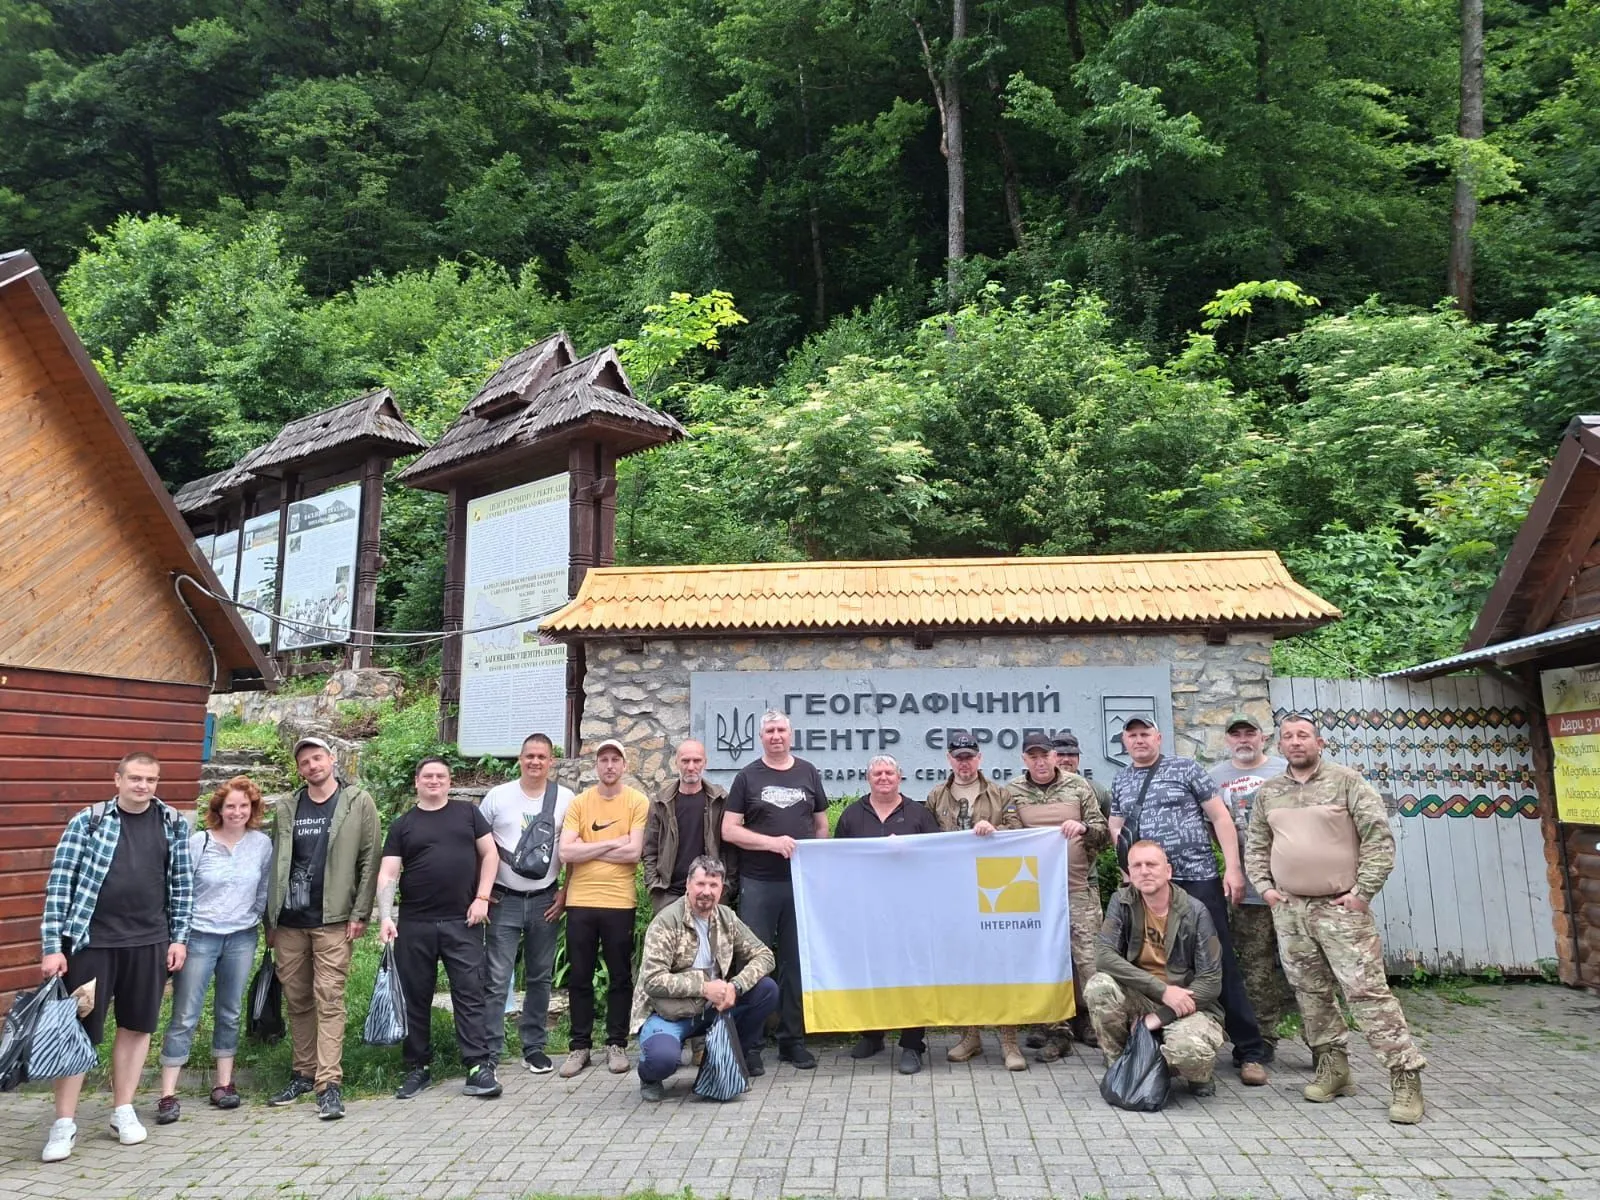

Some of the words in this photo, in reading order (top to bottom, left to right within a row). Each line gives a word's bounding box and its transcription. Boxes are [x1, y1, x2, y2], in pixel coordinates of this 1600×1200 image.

[784, 684, 1060, 715] ГЕОГРАФІЧНИЙ
[1560, 716, 1584, 734] Дари
[1560, 742, 1600, 757] Продукти
[992, 768, 1013, 781] OF
[980, 917, 1042, 930] ІНТЕРПАЙП
